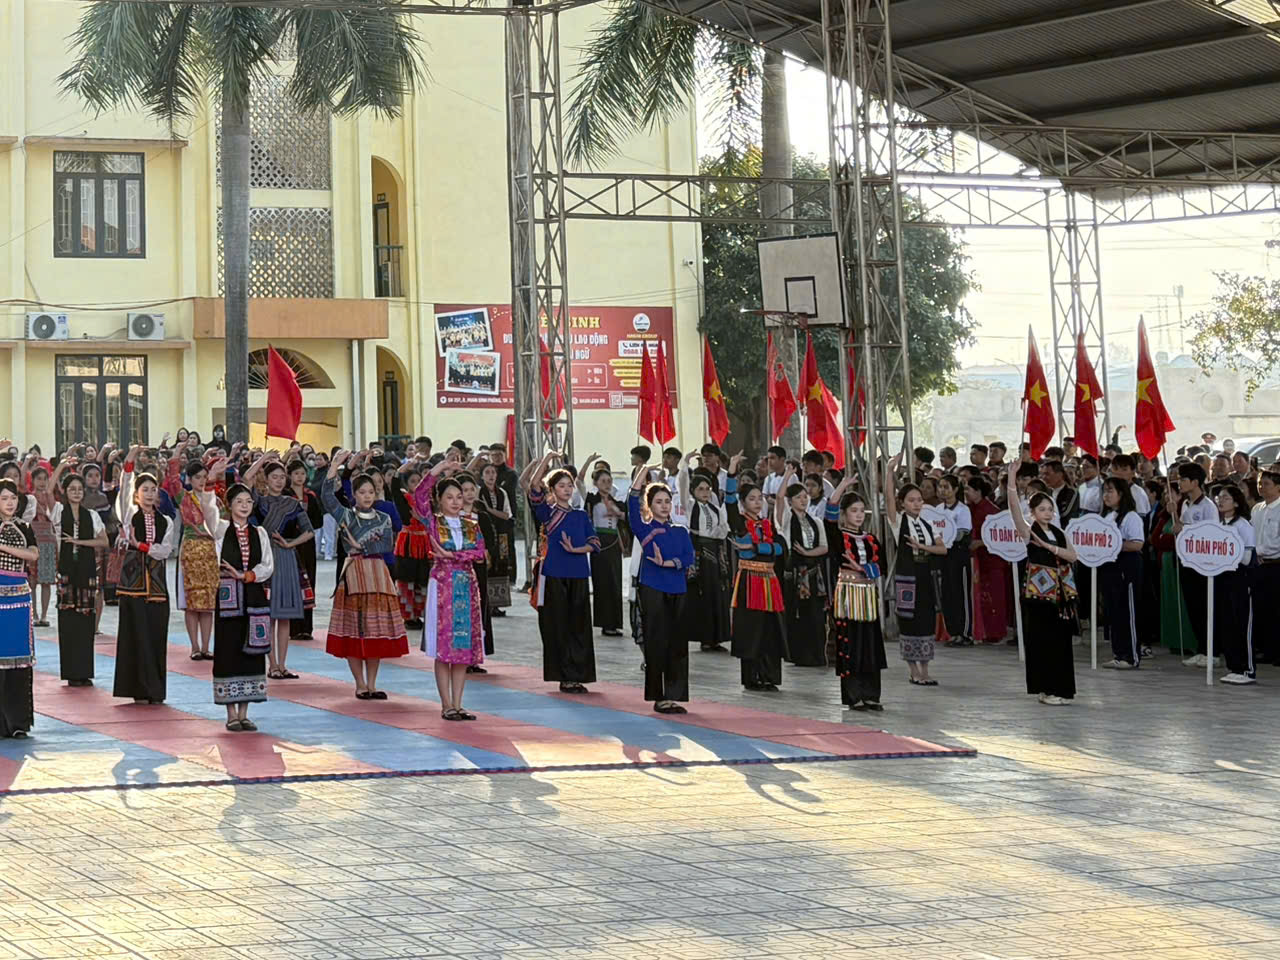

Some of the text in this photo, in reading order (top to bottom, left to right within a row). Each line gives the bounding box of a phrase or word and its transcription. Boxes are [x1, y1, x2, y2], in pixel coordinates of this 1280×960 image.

[569, 316, 600, 328] INH
[574, 334, 588, 344] LAO
[589, 332, 609, 346] ĐỘNG
[1000, 526, 1013, 542] DÂN
[1081, 529, 1093, 546] DÂN
[1094, 528, 1107, 548] PHỐ
[1108, 534, 1112, 548] 2
[1195, 536, 1210, 554] DÂN
[1212, 536, 1228, 556] PHỐ
[1229, 542, 1235, 556] 3
